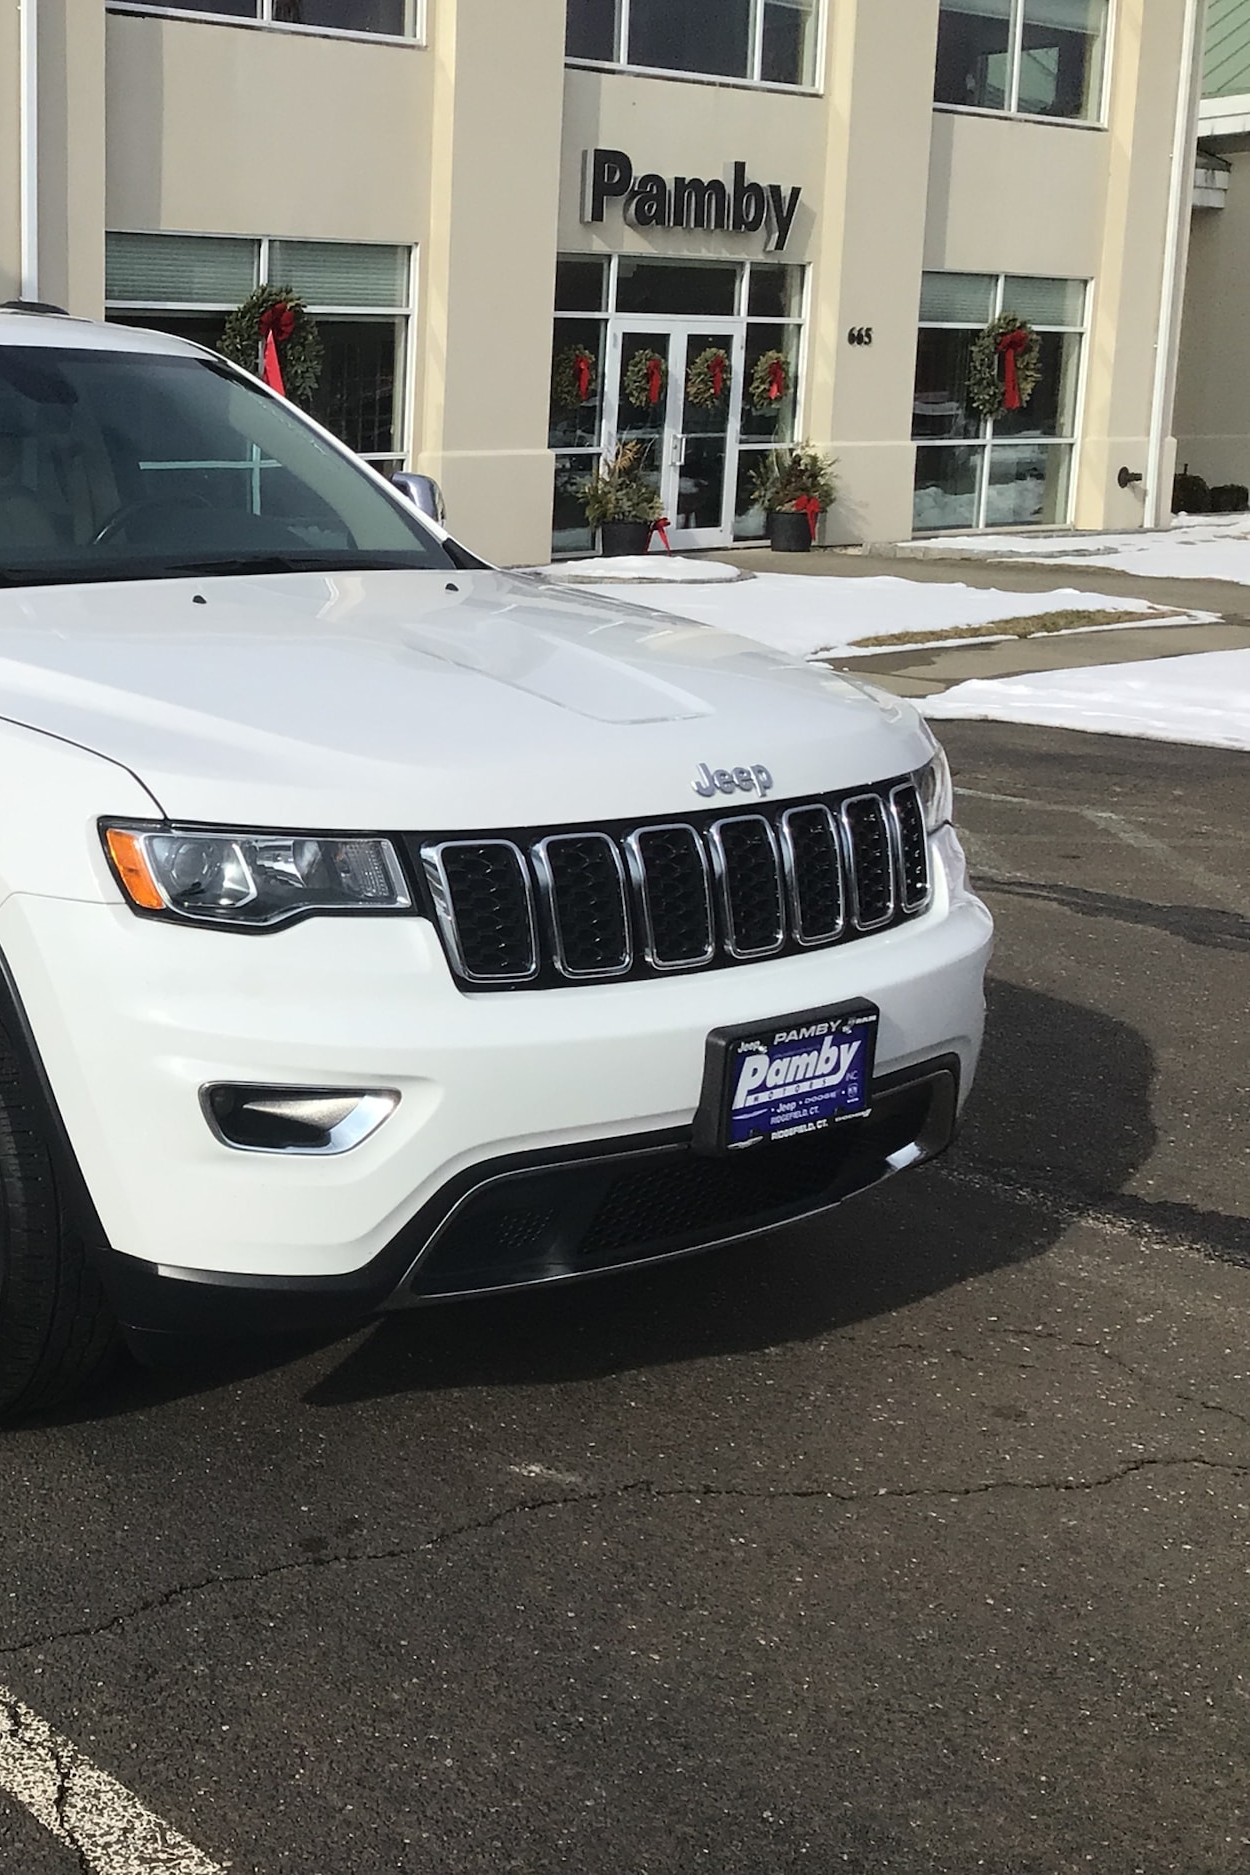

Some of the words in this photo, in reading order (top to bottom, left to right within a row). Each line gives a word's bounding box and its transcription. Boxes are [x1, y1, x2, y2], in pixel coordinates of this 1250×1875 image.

[584, 148, 801, 251] Pamby
[847, 326, 873, 346] 665
[691, 762, 773, 798] Jeep
[773, 1019, 842, 1045] PAMBY
[737, 1040, 761, 1053] Jeep
[731, 1035, 862, 1110] Pamby
[753, 1078, 827, 1103] MOTORS
[776, 1101, 797, 1113] Jeep
